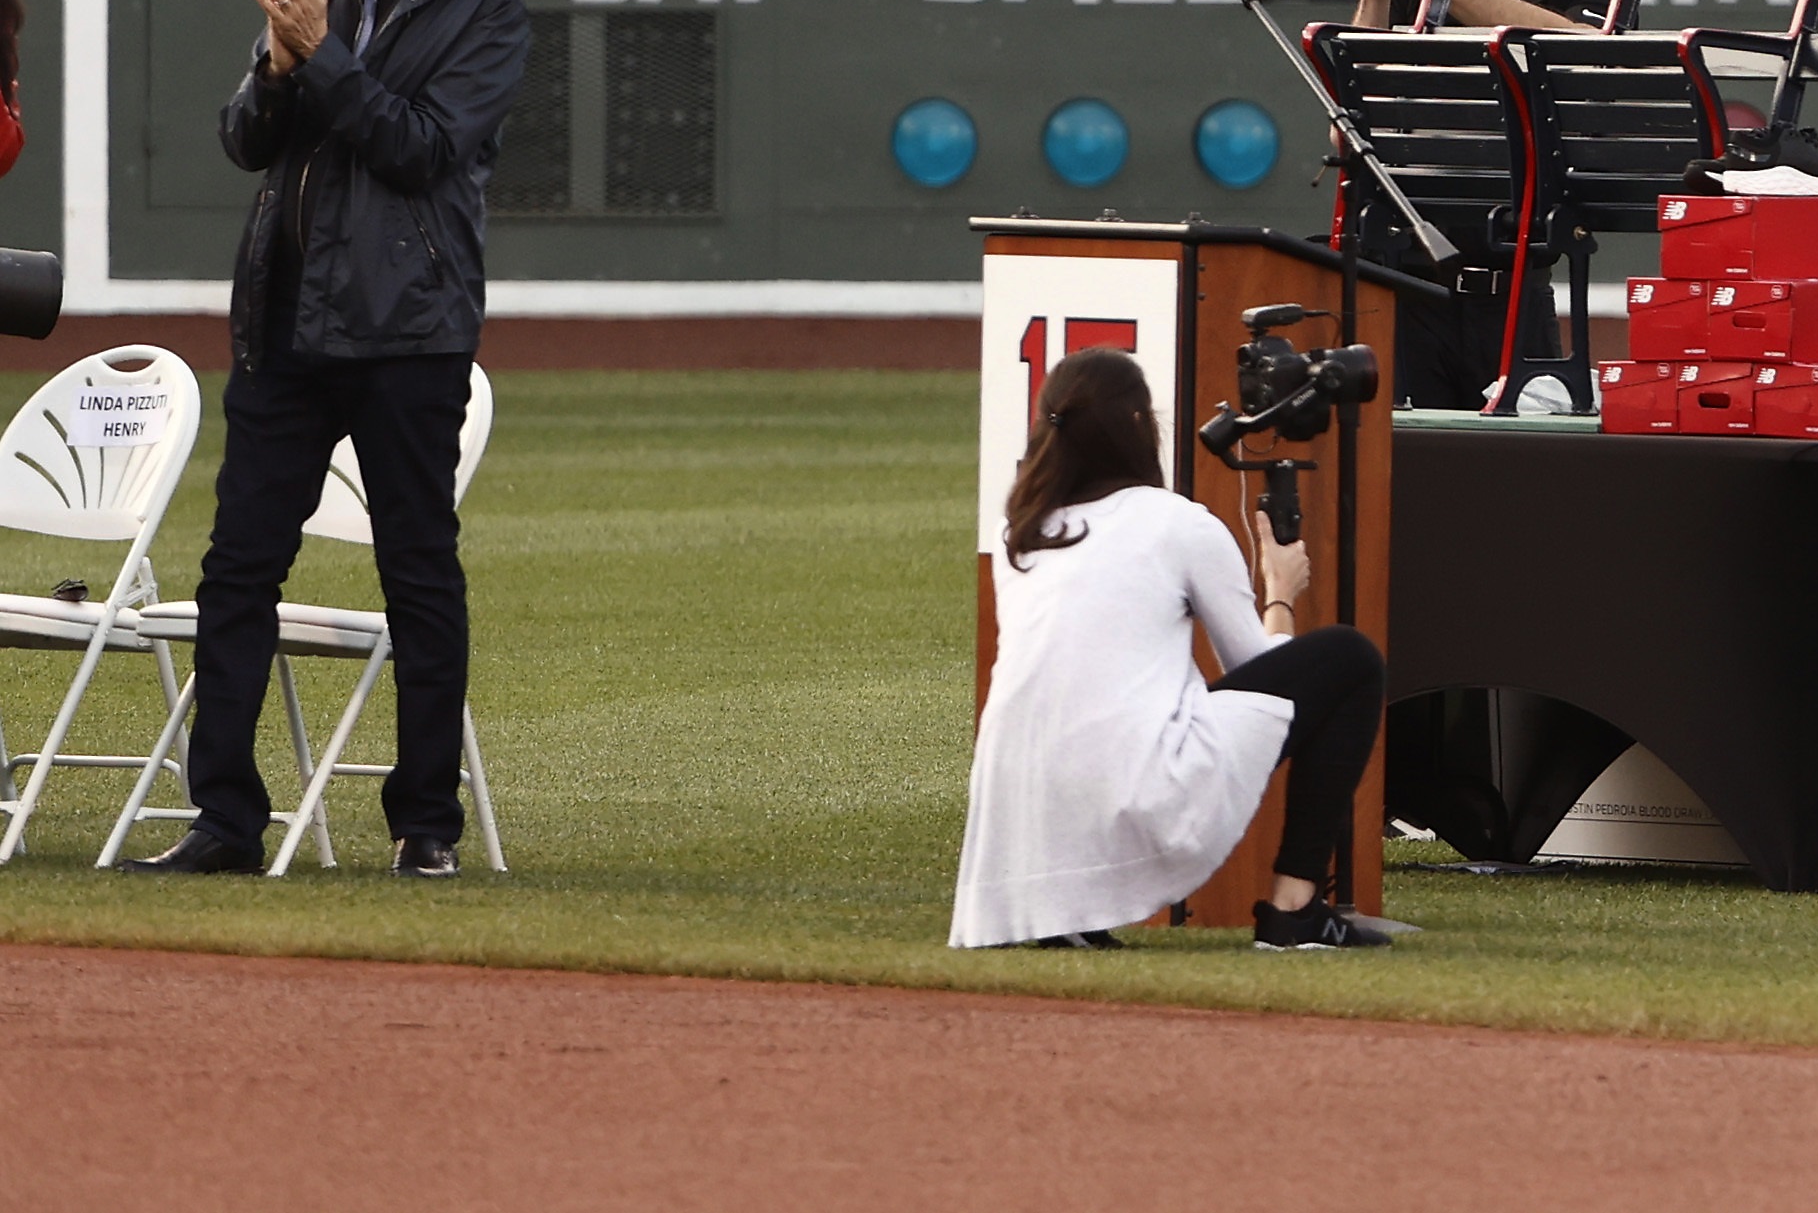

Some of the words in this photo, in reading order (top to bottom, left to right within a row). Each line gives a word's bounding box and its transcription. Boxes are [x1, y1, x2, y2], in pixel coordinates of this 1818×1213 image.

[80, 396, 123, 411] LINDA
[103, 421, 146, 437] HENRY
[1596, 804, 1636, 816] PEDROIA
[1640, 806, 1672, 818] BLOOD
